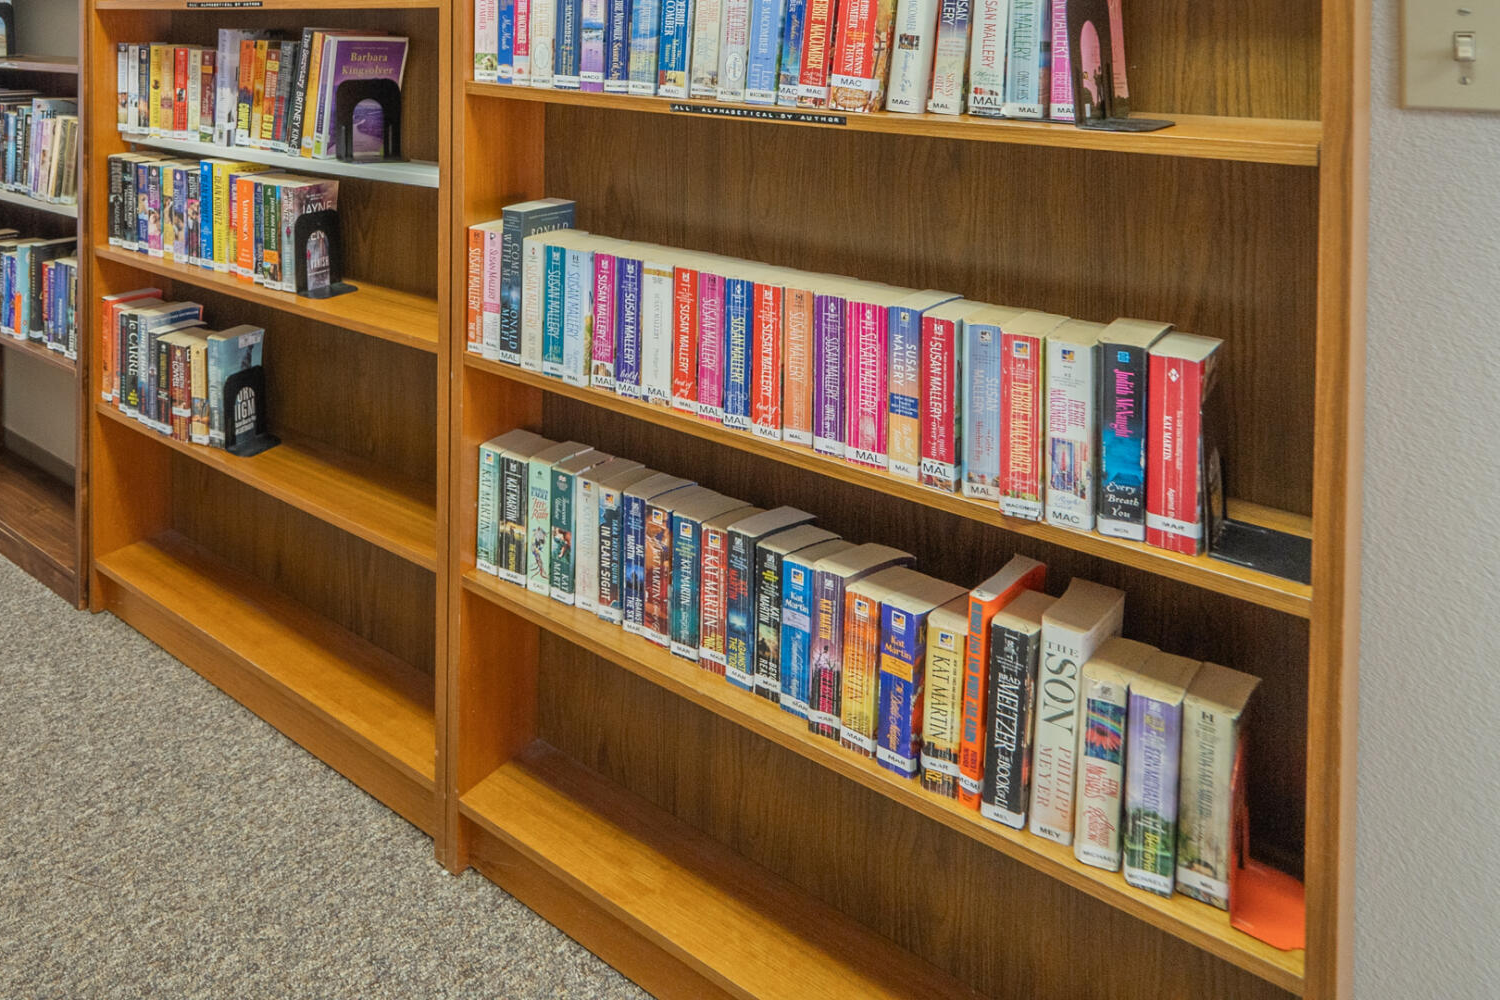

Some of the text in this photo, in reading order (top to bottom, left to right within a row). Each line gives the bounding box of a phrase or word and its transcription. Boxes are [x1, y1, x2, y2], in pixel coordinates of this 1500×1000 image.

[759, 6, 771, 54] MACOMBER
[981, 23, 996, 69] MALLERY
[350, 51, 388, 63] Barbara
[807, 23, 827, 70] MACOMBER
[844, 44, 854, 72] THAYNE
[854, 42, 865, 75] RAEANNE
[297, 49, 308, 89] Secretary
[342, 64, 394, 76] Kingsolver
[840, 79, 861, 88] MAC
[292, 91, 303, 127] BRITNEY
[674, 104, 691, 112] ALL
[701, 106, 774, 119] ALPHABETICAL
[799, 114, 840, 123] AUTHOR
[972, 97, 999, 106] MAL
[262, 114, 274, 140] GUN
[214, 176, 222, 225] DEAN KOONTZ
[502, 233, 512, 283] WITH ME
[511, 243, 519, 276] COME
[547, 269, 560, 339] SUSAN MALLERY
[566, 272, 580, 339] SUSAN MALLERY
[596, 274, 608, 340] SUSAN MALLERY
[129, 320, 138, 330] le
[501, 309, 510, 341] MALFI
[510, 303, 518, 350] RONALD
[623, 292, 634, 366] SUSAN MALLERY
[678, 303, 689, 374] SUSAN MALLERY
[701, 298, 717, 369] SUSAN MALLERY
[500, 352, 520, 360] MAL
[731, 317, 745, 383] SUSAN MALLERY
[761, 324, 773, 397] SUSAN MALLERY
[893, 334, 904, 386] MALLERY
[905, 343, 917, 382] SUSAN
[595, 376, 615, 387] MAL
[619, 384, 639, 393] MAL
[647, 387, 668, 398] MAL
[929, 341, 942, 420] SUSAN MALLERY
[699, 405, 720, 417] MAL
[1109, 369, 1134, 439] Judith McNaught
[724, 416, 746, 427] MAL
[759, 428, 779, 438] MAL
[855, 450, 882, 464] MAL
[929, 443, 937, 457] you
[922, 463, 949, 479] MAL
[1105, 482, 1137, 495] Every
[1107, 494, 1140, 507] Breath
[1051, 511, 1079, 524] MAC
[1111, 507, 1131, 518] You
[600, 526, 611, 601] IN PLAIN SIGHT
[704, 553, 718, 627] KAT MARTIN
[790, 591, 803, 600] Kat
[785, 600, 809, 614] Martin
[728, 637, 737, 669] THE TIDE
[738, 640, 746, 672] AGAINST
[884, 645, 912, 660] Martin
[890, 635, 905, 647] Kat
[1047, 641, 1079, 658] THE
[929, 655, 950, 740] KAT MARTIN
[1041, 653, 1077, 736] SON
[993, 681, 1020, 790] MELTZER BOOK
[1036, 744, 1052, 808] MEYER
[1056, 746, 1073, 819] PHILIPP
[1103, 779, 1120, 799] FERN
[1038, 825, 1060, 839] MEY
